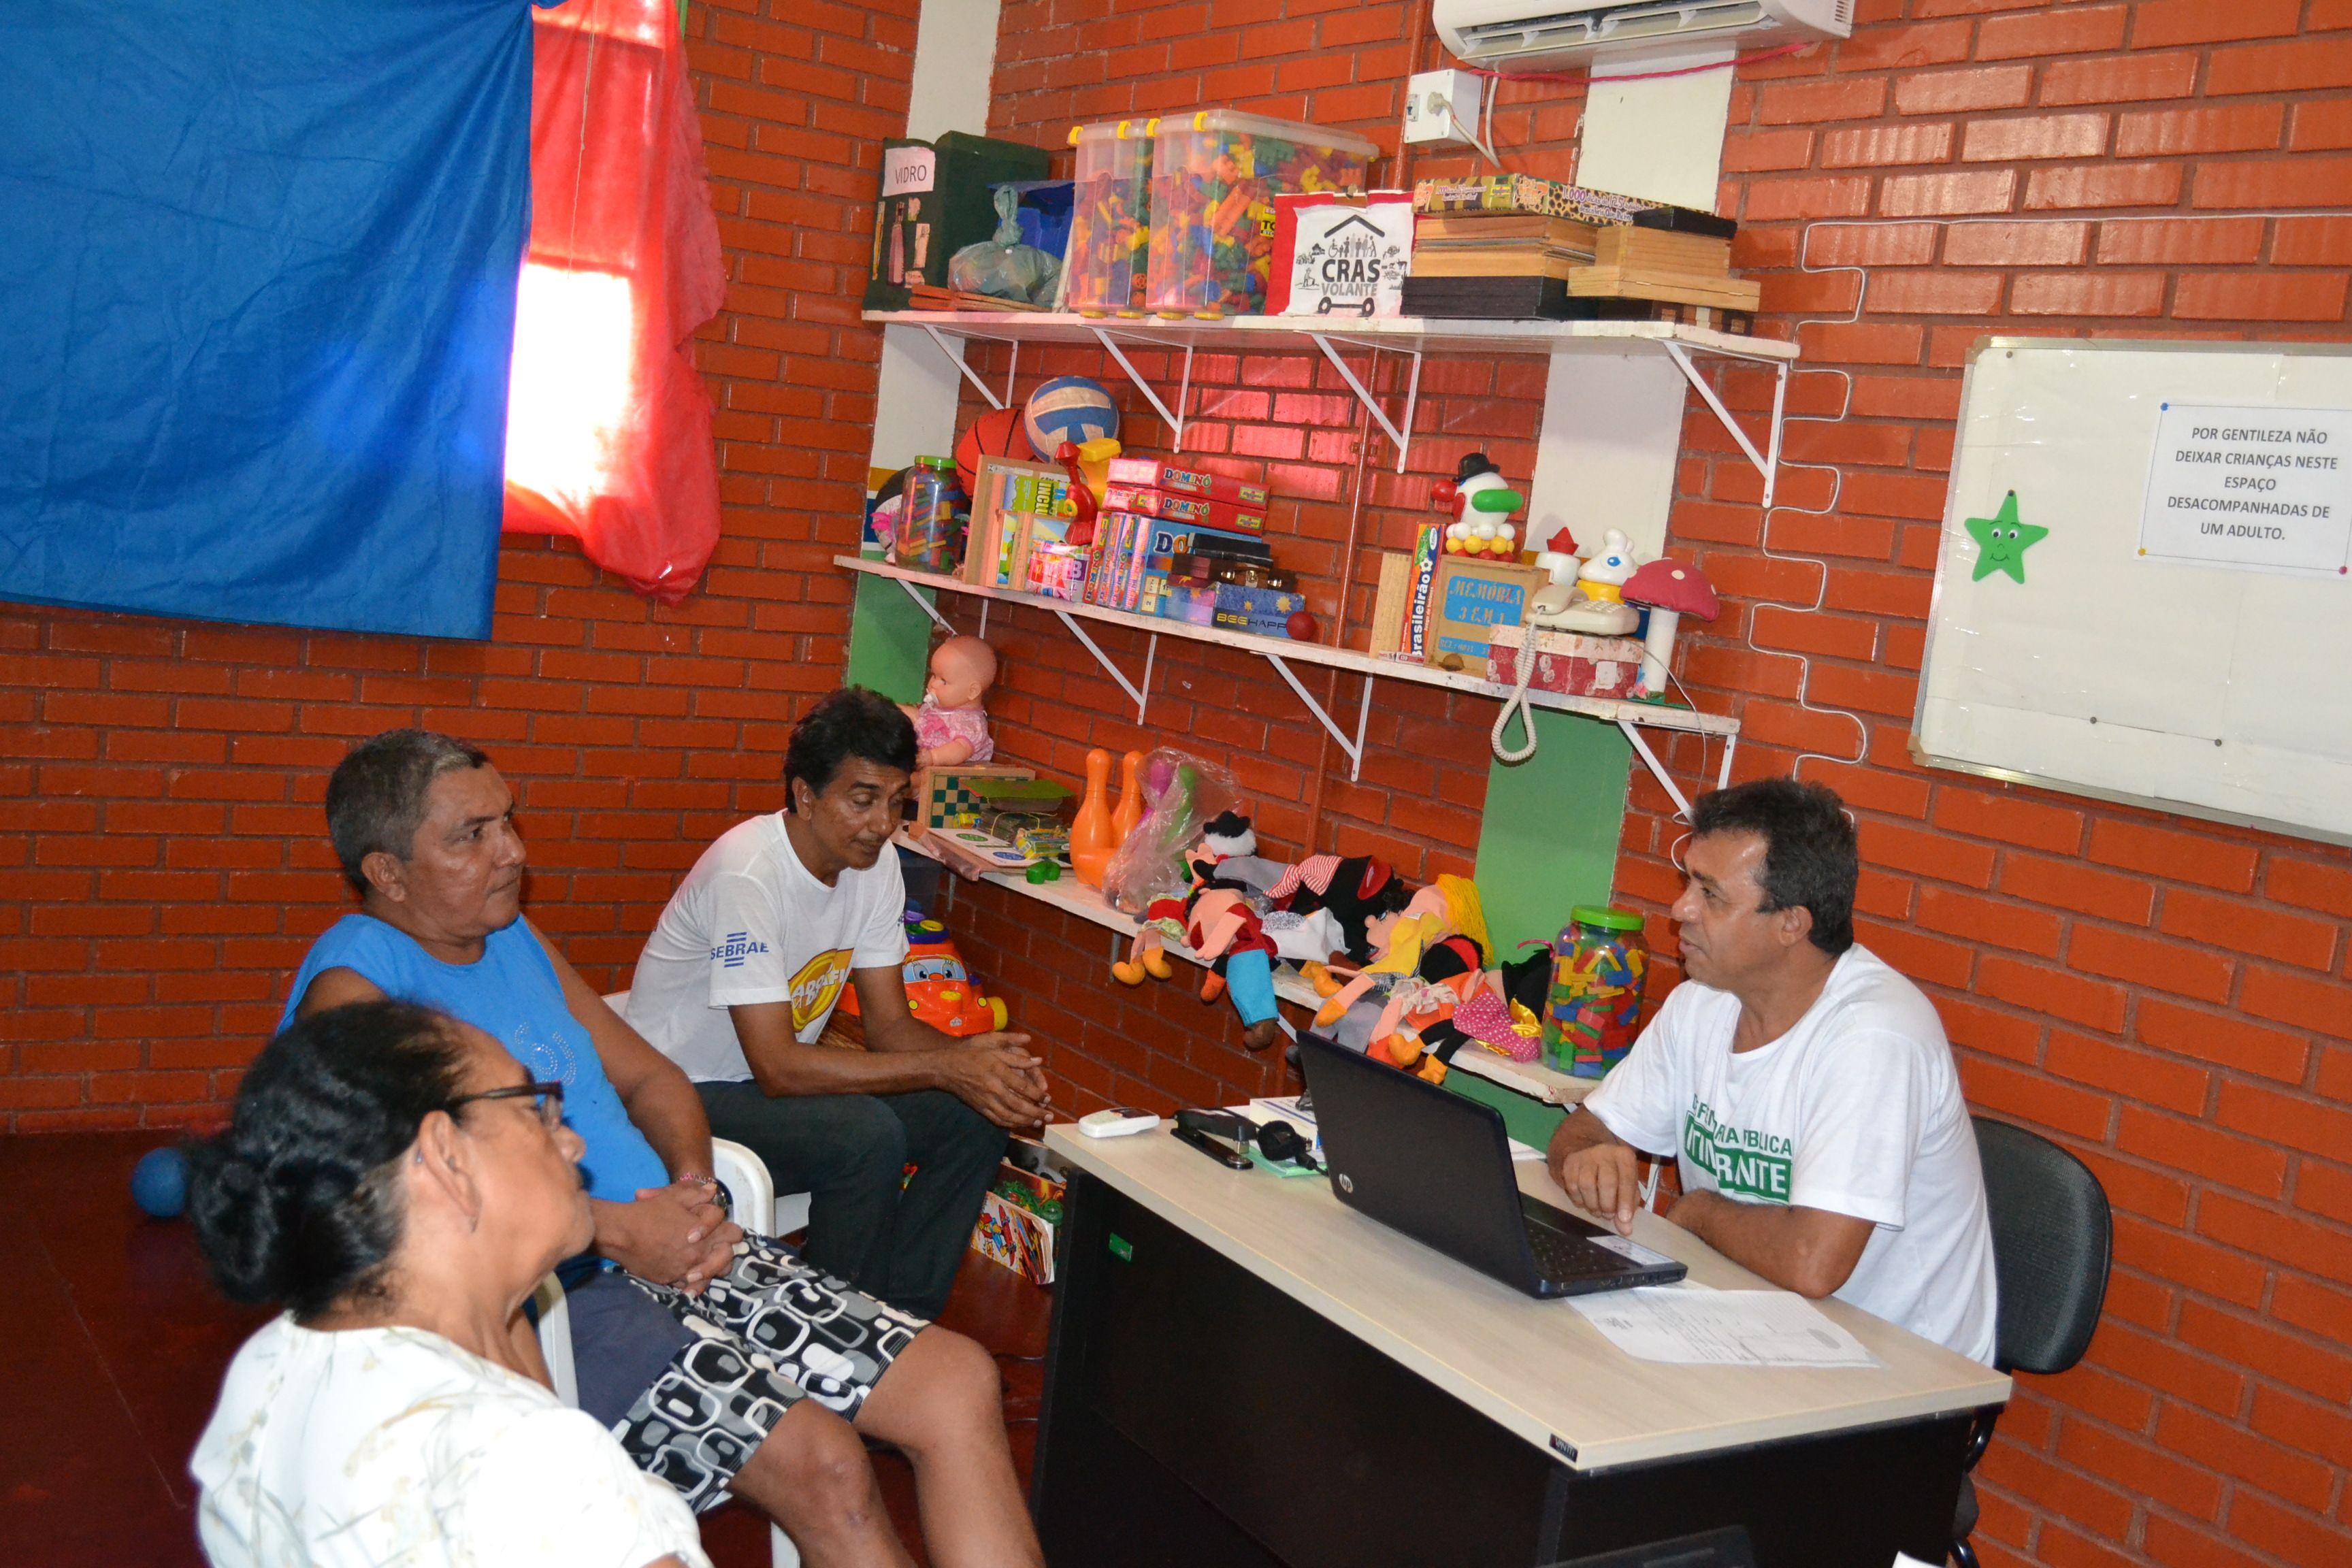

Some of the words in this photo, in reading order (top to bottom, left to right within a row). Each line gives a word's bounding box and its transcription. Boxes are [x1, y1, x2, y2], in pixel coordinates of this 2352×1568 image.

[896, 165, 927, 184] VIDRO
[1322, 259, 1381, 283] CRAS
[1321, 283, 1378, 296] VOLANTE
[2192, 427, 2218, 440] POR
[2222, 428, 2292, 443] GENTILEZA
[2296, 429, 2328, 444] NÃO
[2175, 450, 2221, 464] DEIXAR
[2225, 453, 2291, 469] CRIANÇAS
[2296, 456, 2338, 470] NESTE
[1164, 468, 1211, 487] DOMINÓ
[2224, 476, 2276, 492] ESPAÇO
[1164, 497, 1209, 516] DOMINÓ
[2168, 495, 2308, 517] DESACOMPANHADAS
[2312, 506, 2330, 519] DE
[2200, 523, 2223, 536] UM
[2227, 524, 2285, 540] ADULTO.
[1154, 532, 1191, 555] DO
[1085, 550, 1101, 600] DOMINÓ
[710, 941, 770, 960] SEBRAE
